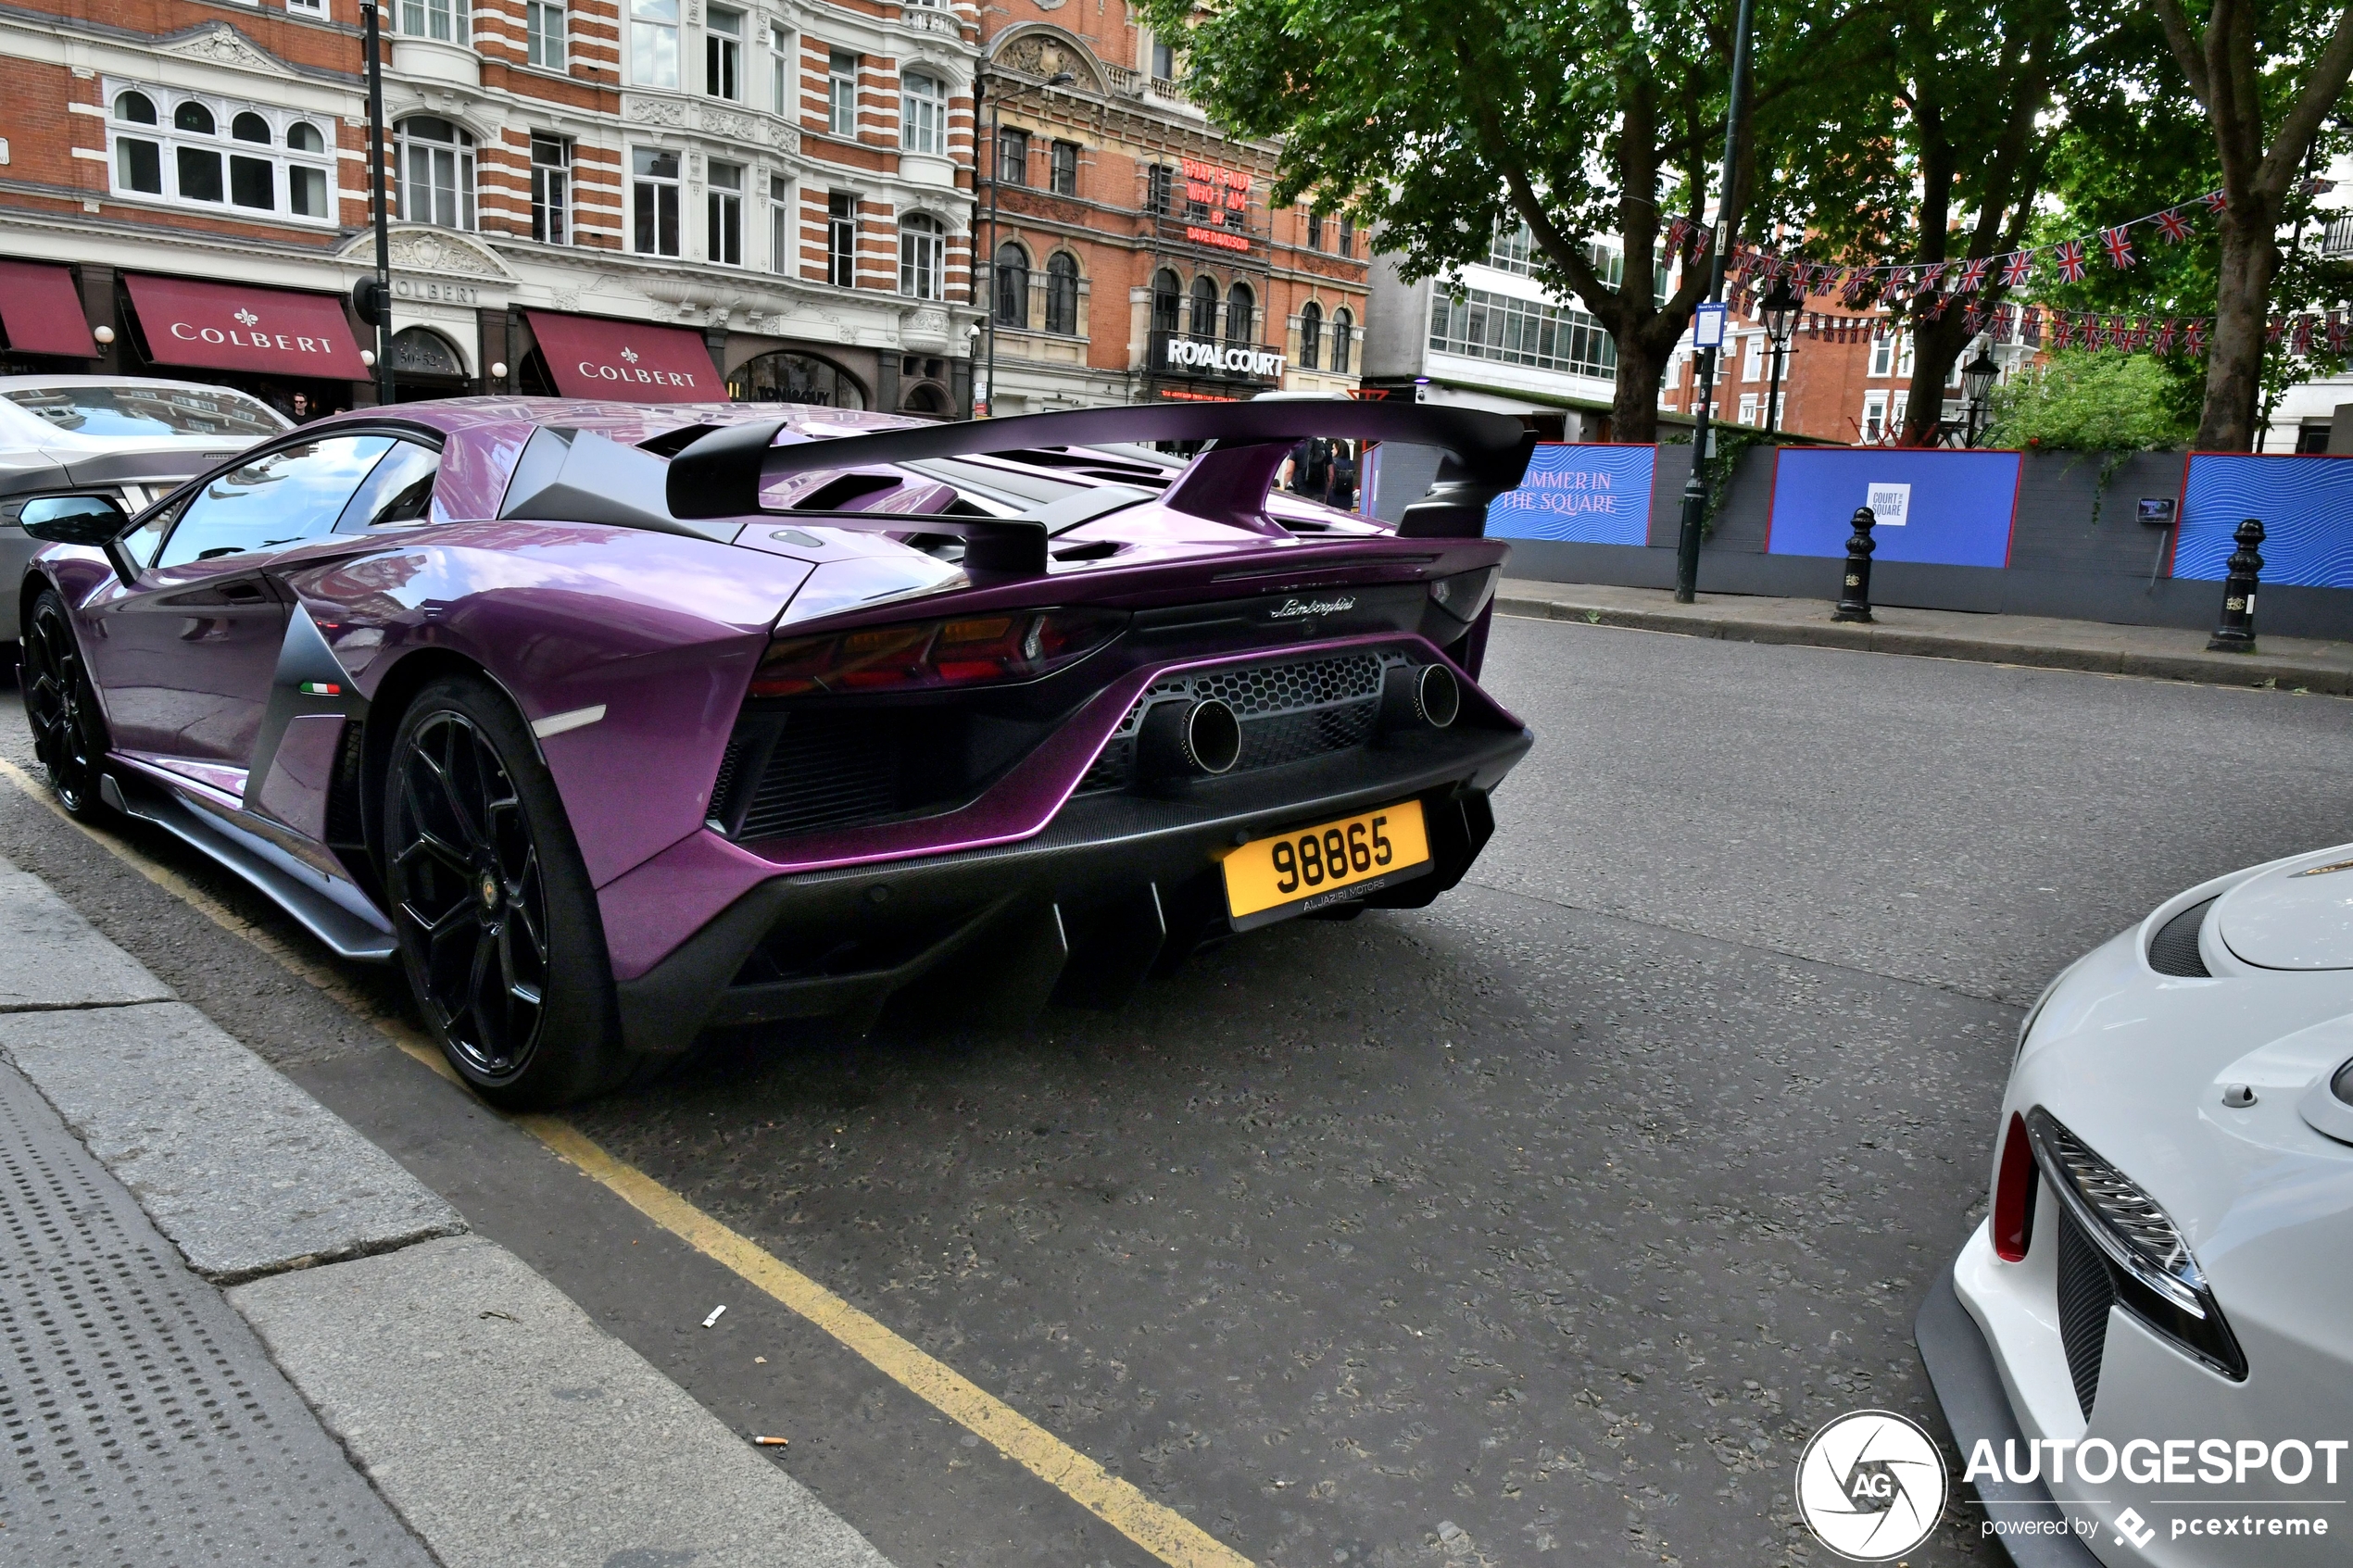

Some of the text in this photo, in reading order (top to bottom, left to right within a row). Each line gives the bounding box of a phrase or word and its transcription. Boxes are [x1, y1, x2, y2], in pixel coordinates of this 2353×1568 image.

[1181, 157, 1252, 193] THAT IS NOT
[1187, 182, 1246, 211] WHO I AM
[1211, 210, 1225, 224] BY
[1187, 227, 1249, 250] DAVE DAVIDSON
[389, 280, 479, 304] OLBERT
[170, 322, 332, 354] COLBERT
[400, 345, 437, 367] 50-52
[1168, 339, 1287, 377] ROYAL COURT
[578, 361, 695, 387] COLBERT
[1520, 470, 1611, 490] UMMER IN
[1503, 491, 1617, 516] THE SQUARE
[1873, 492, 1898, 504] COURT
[1872, 504, 1902, 517] SQUARE
[1270, 596, 1356, 617] Lamborghini
[1272, 816, 1392, 893] 98865
[1349, 879, 1385, 897] MOTORS
